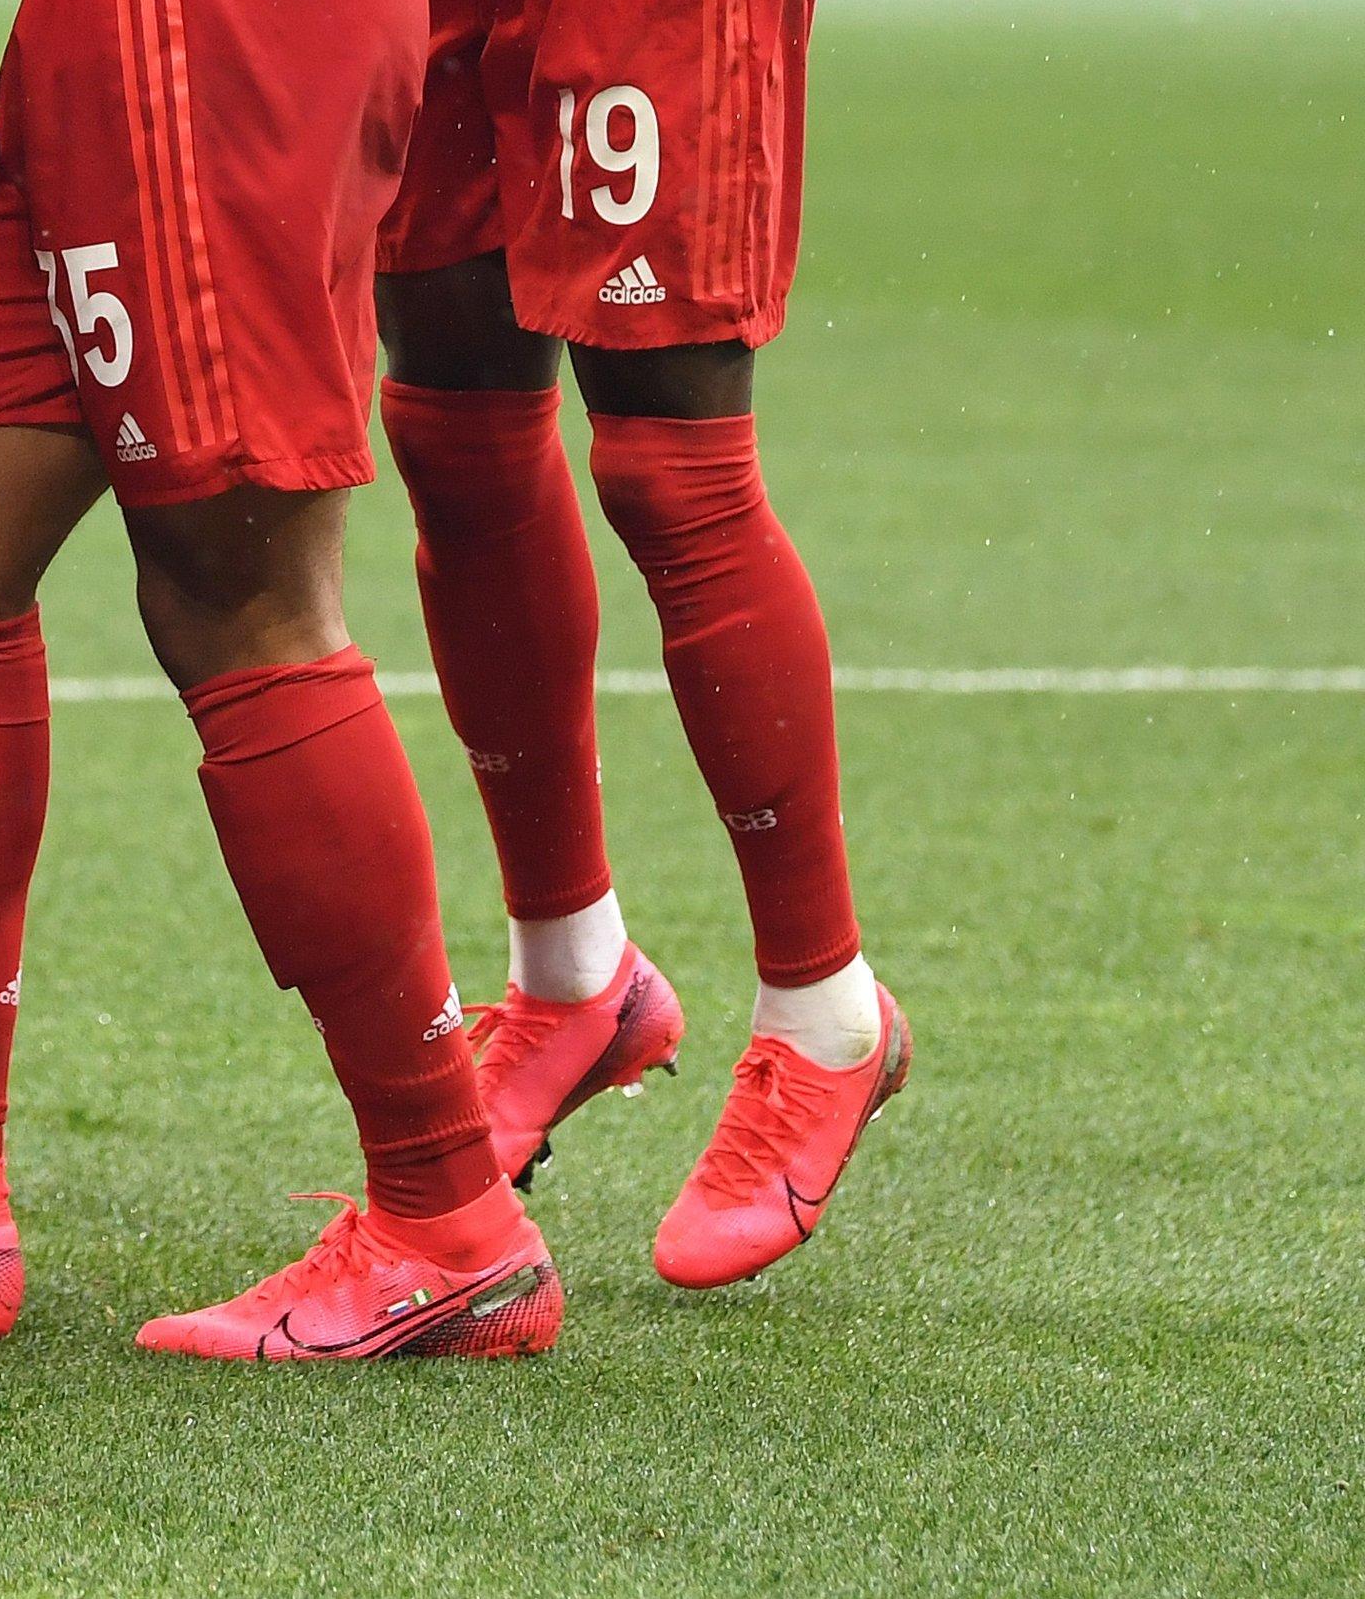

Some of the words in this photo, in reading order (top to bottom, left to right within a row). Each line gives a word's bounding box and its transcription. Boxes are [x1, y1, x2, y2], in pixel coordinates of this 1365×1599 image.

[558, 84, 660, 226] 19
[598, 285, 666, 305] adidas
[117, 442, 158, 462] adidas
[725, 808, 777, 832] CB
